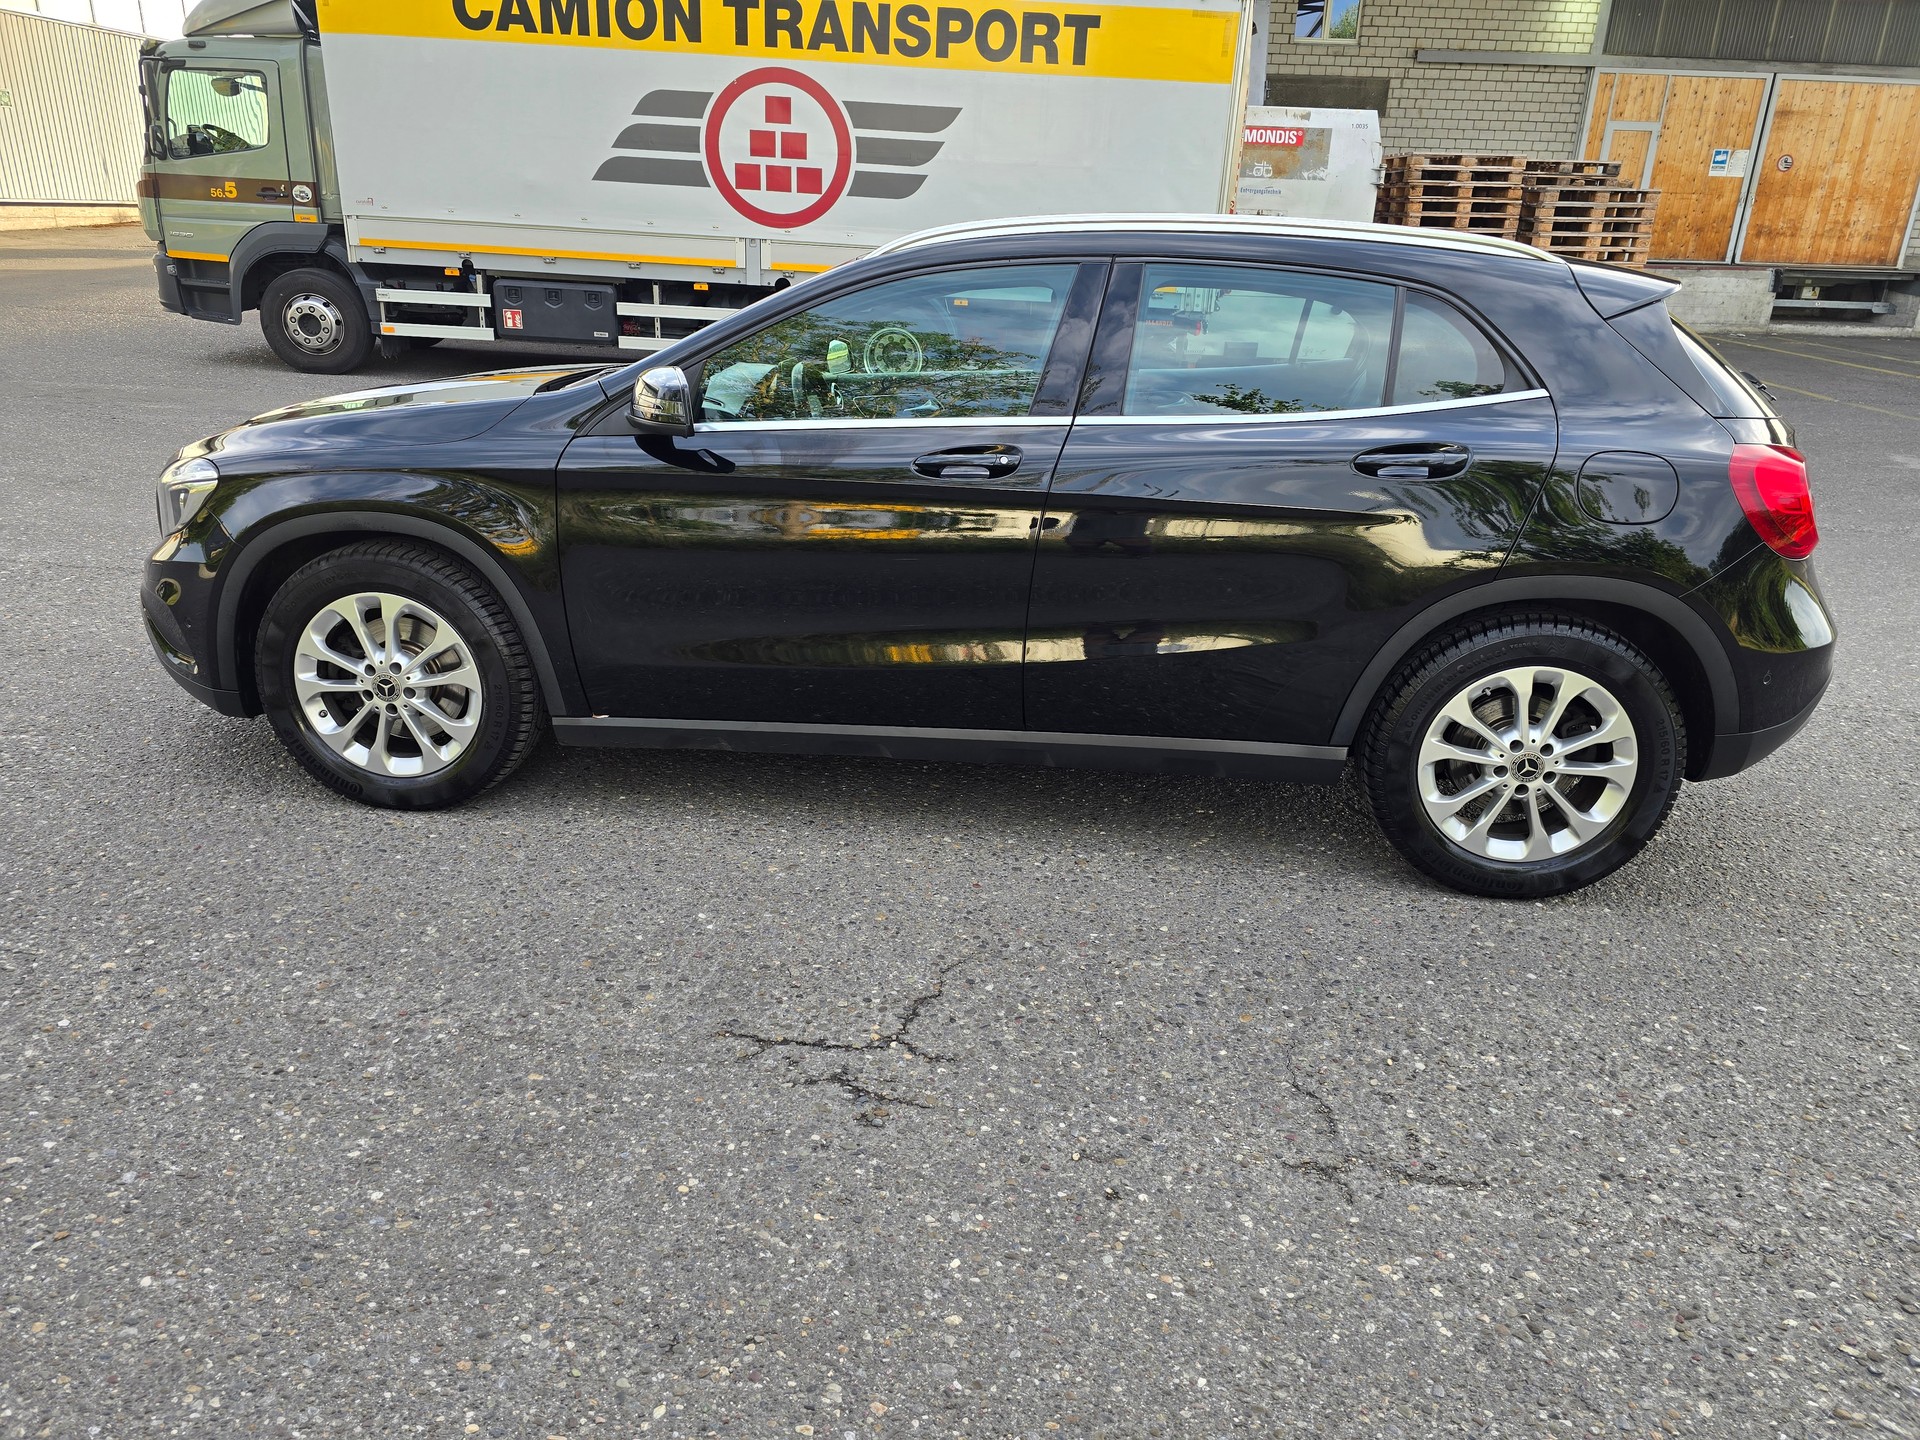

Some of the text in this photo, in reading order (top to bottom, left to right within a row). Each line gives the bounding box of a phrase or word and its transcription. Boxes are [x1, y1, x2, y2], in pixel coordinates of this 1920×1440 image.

[452, 0, 1101, 65] CAMION TRANSPORT
[1655, 718, 1670, 756] 215/60
[1659, 771, 1669, 781] 17
